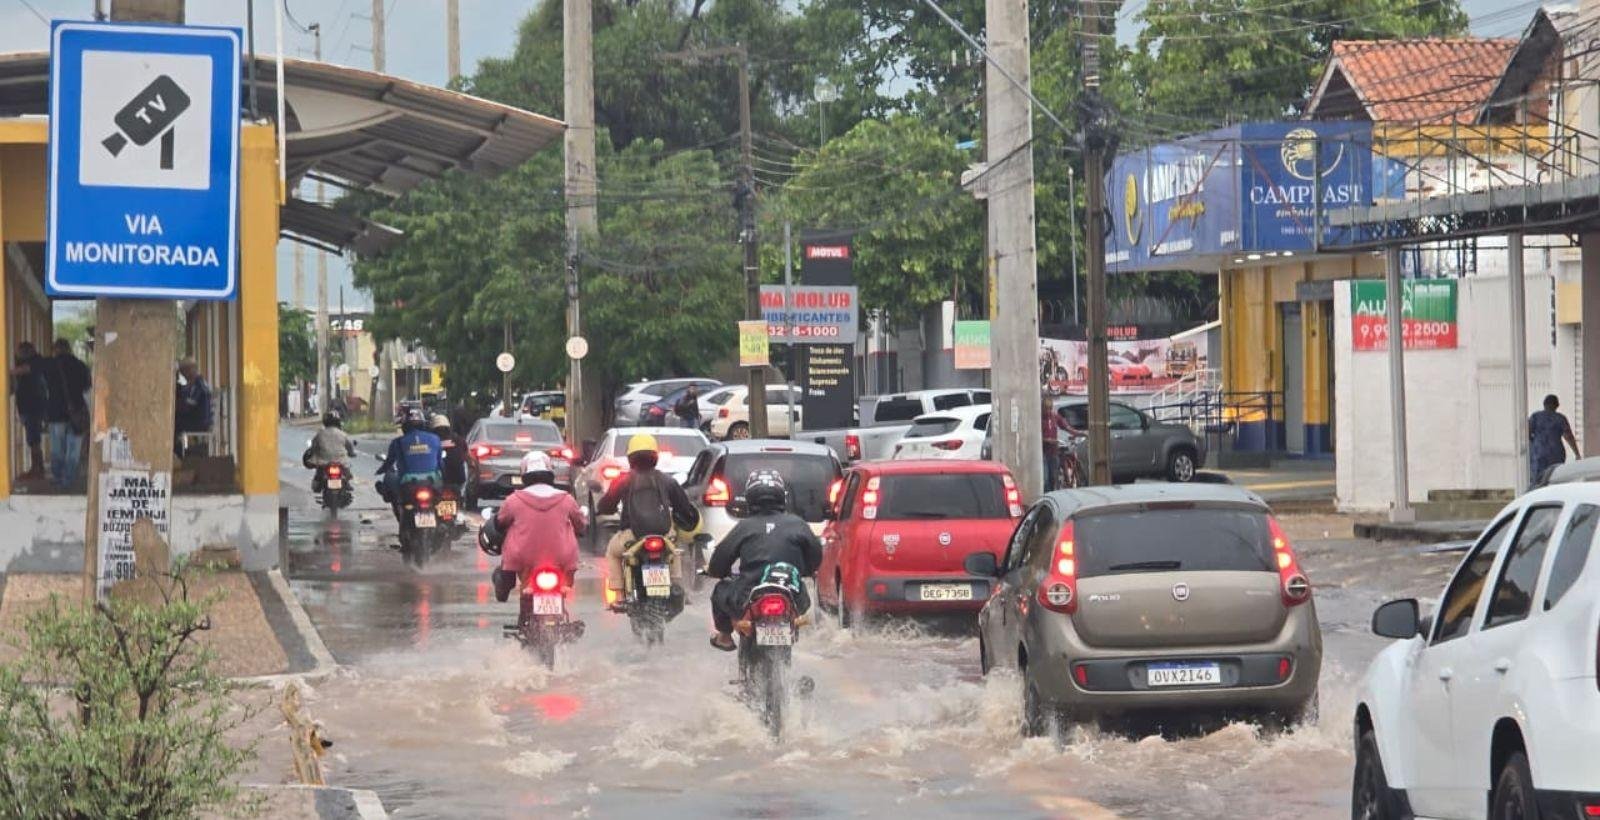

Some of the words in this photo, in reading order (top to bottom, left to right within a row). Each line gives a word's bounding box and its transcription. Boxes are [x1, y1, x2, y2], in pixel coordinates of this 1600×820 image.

[135, 93, 167, 125] TV
[125, 214, 163, 236] VIA
[65, 241, 220, 267] MONITORADA
[810, 246, 843, 258] MOTUL
[759, 292, 850, 308] MAROLUB
[1356, 299, 1414, 318] ALUA
[131, 500, 150, 509] DE
